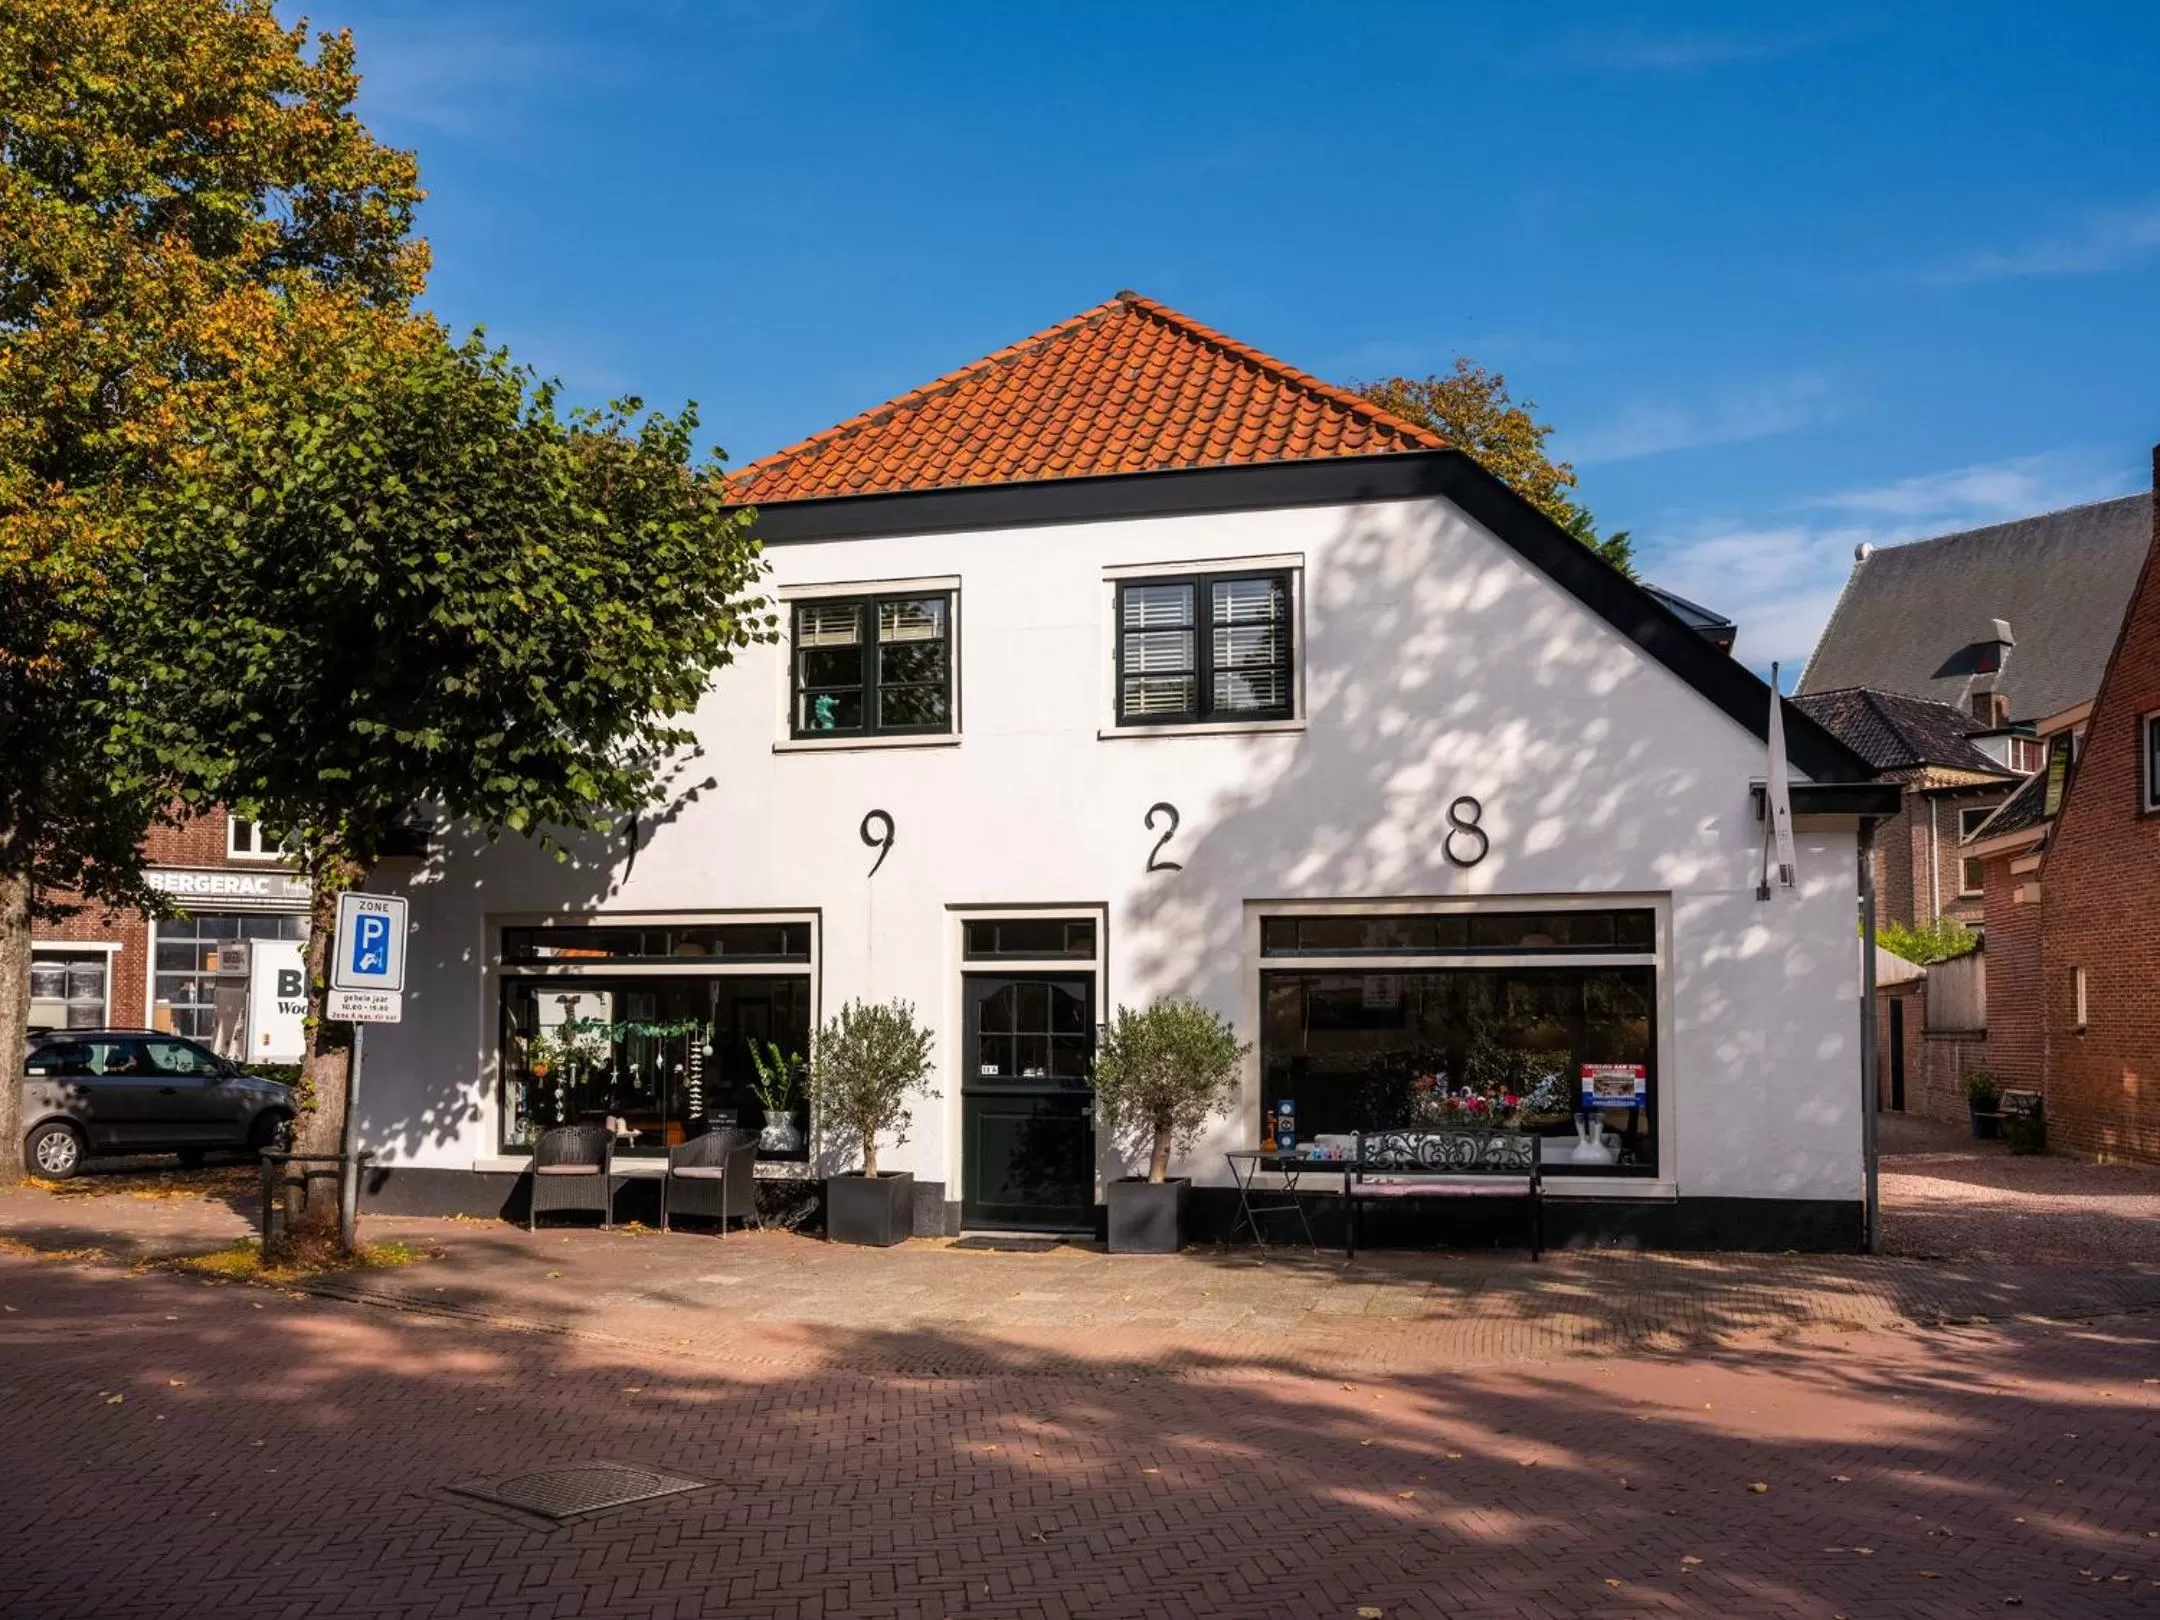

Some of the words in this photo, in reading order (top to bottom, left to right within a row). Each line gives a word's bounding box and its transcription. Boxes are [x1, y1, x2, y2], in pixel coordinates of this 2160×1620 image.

[860, 808, 895, 879] 9
[1144, 802, 1183, 873] 2
[1444, 795, 1490, 868] 8
[148, 872, 270, 894] BERGERAC
[359, 900, 390, 913] ZONE
[362, 919, 384, 949] P
[277, 968, 308, 998] B
